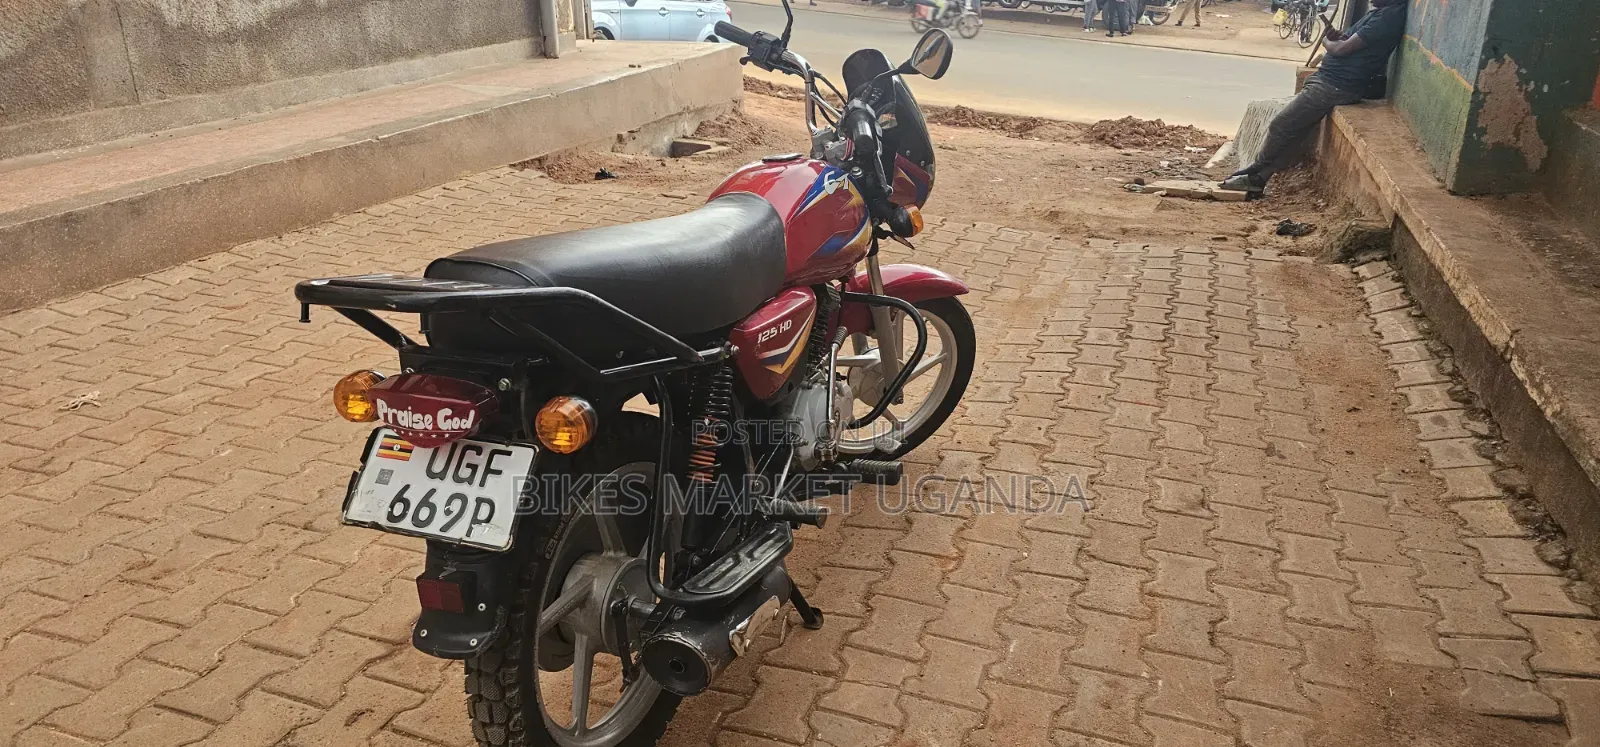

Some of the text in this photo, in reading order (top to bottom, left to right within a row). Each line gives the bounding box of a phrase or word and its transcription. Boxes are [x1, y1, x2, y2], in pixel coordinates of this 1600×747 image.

[757, 319, 792, 344] 125 HD
[376, 398, 475, 430] Praise God
[426, 441, 513, 488] UGF
[386, 483, 496, 538] 669P
